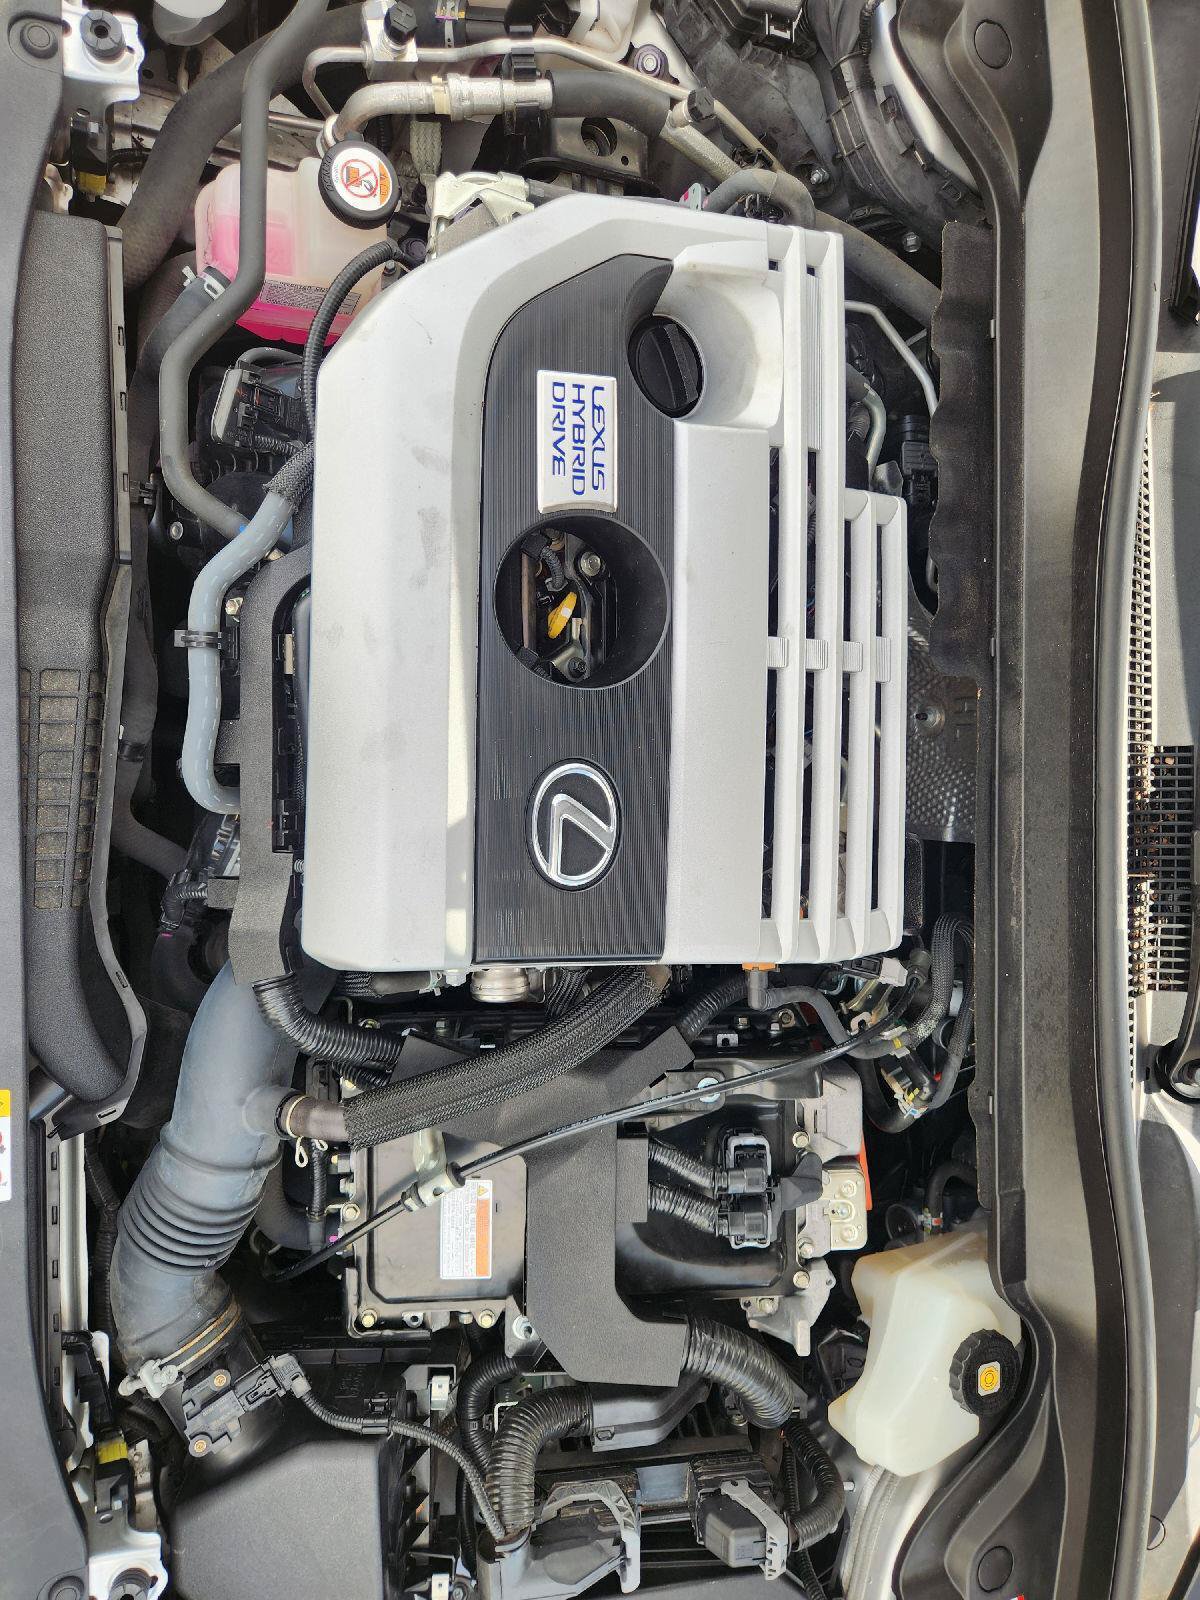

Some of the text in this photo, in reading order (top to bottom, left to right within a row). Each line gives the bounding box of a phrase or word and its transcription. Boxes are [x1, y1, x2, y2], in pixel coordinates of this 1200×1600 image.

[552, 382, 566, 477] DRIVE
[572, 384, 586, 495] HYBRID
[591, 386, 605, 491] LEXUS
